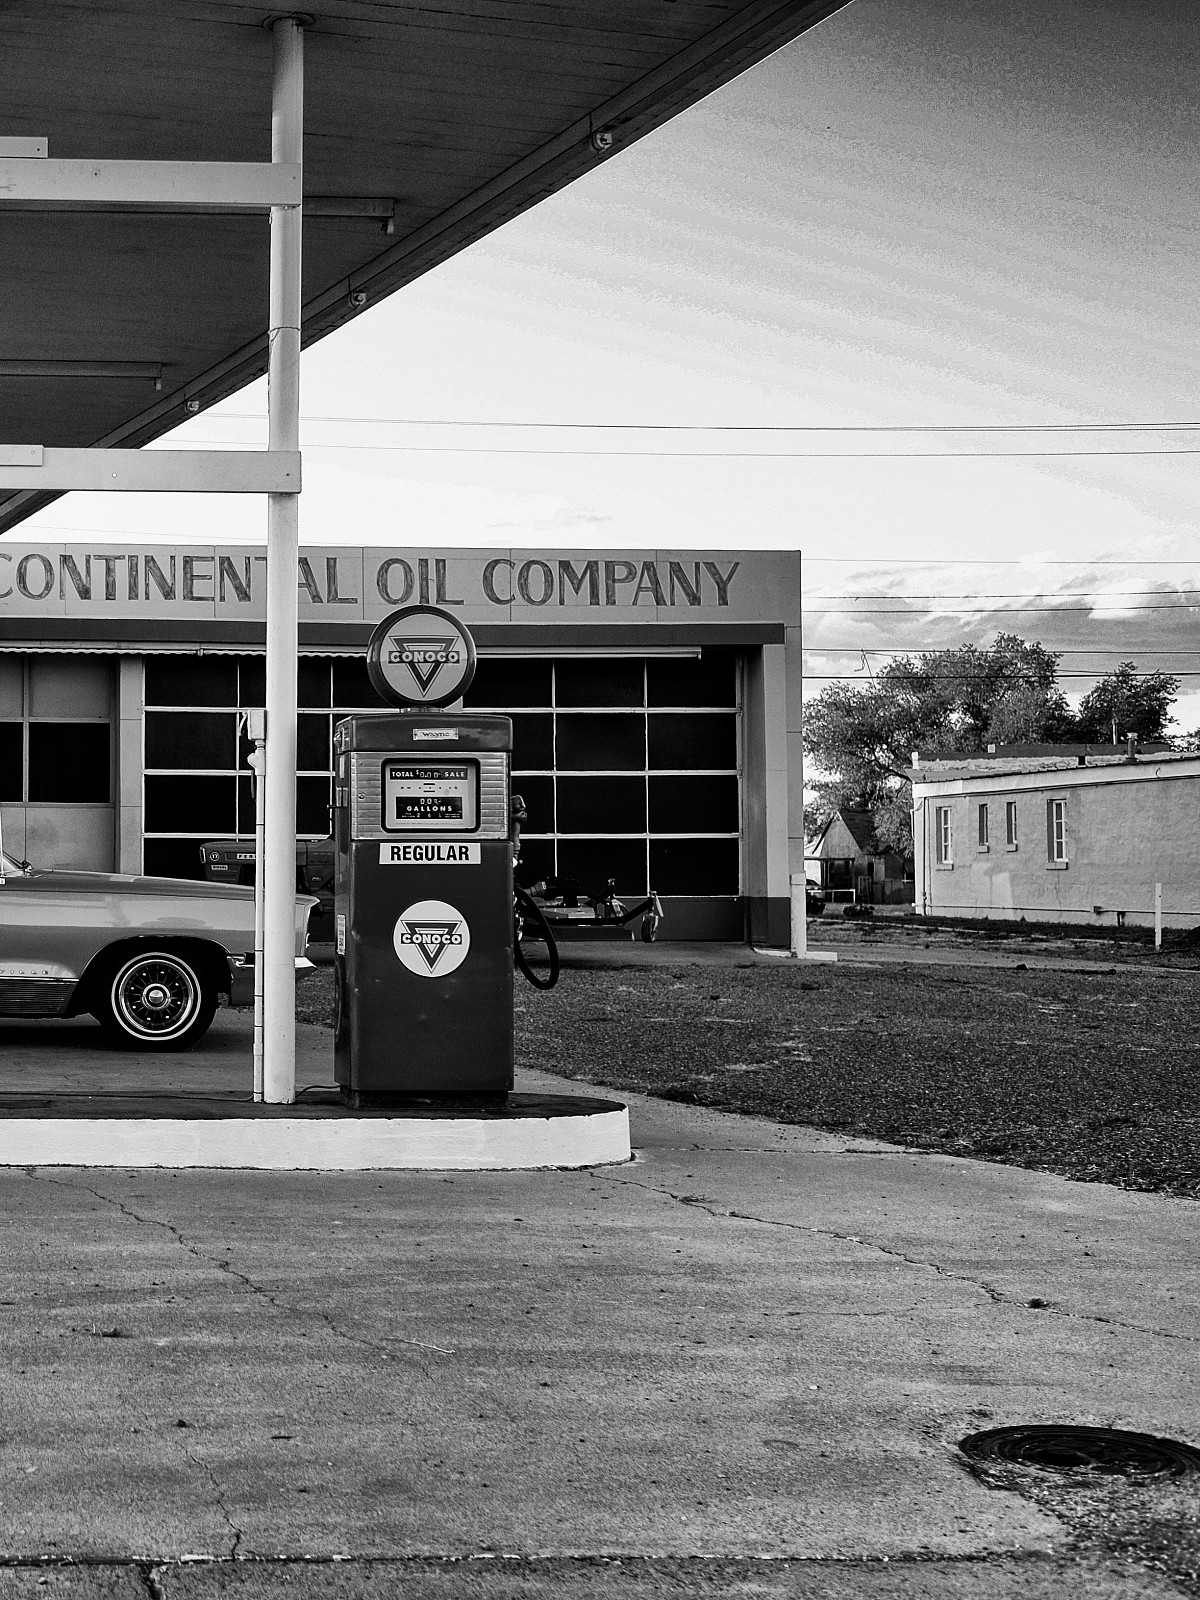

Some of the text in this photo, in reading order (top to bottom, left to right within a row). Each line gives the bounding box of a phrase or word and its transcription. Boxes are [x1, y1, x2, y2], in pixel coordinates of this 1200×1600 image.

[375, 557, 465, 605] OIL
[482, 559, 742, 606] COMPANY
[390, 651, 458, 662] CONOCO
[390, 845, 470, 861] REGULAR
[402, 933, 462, 944] CONOCO
